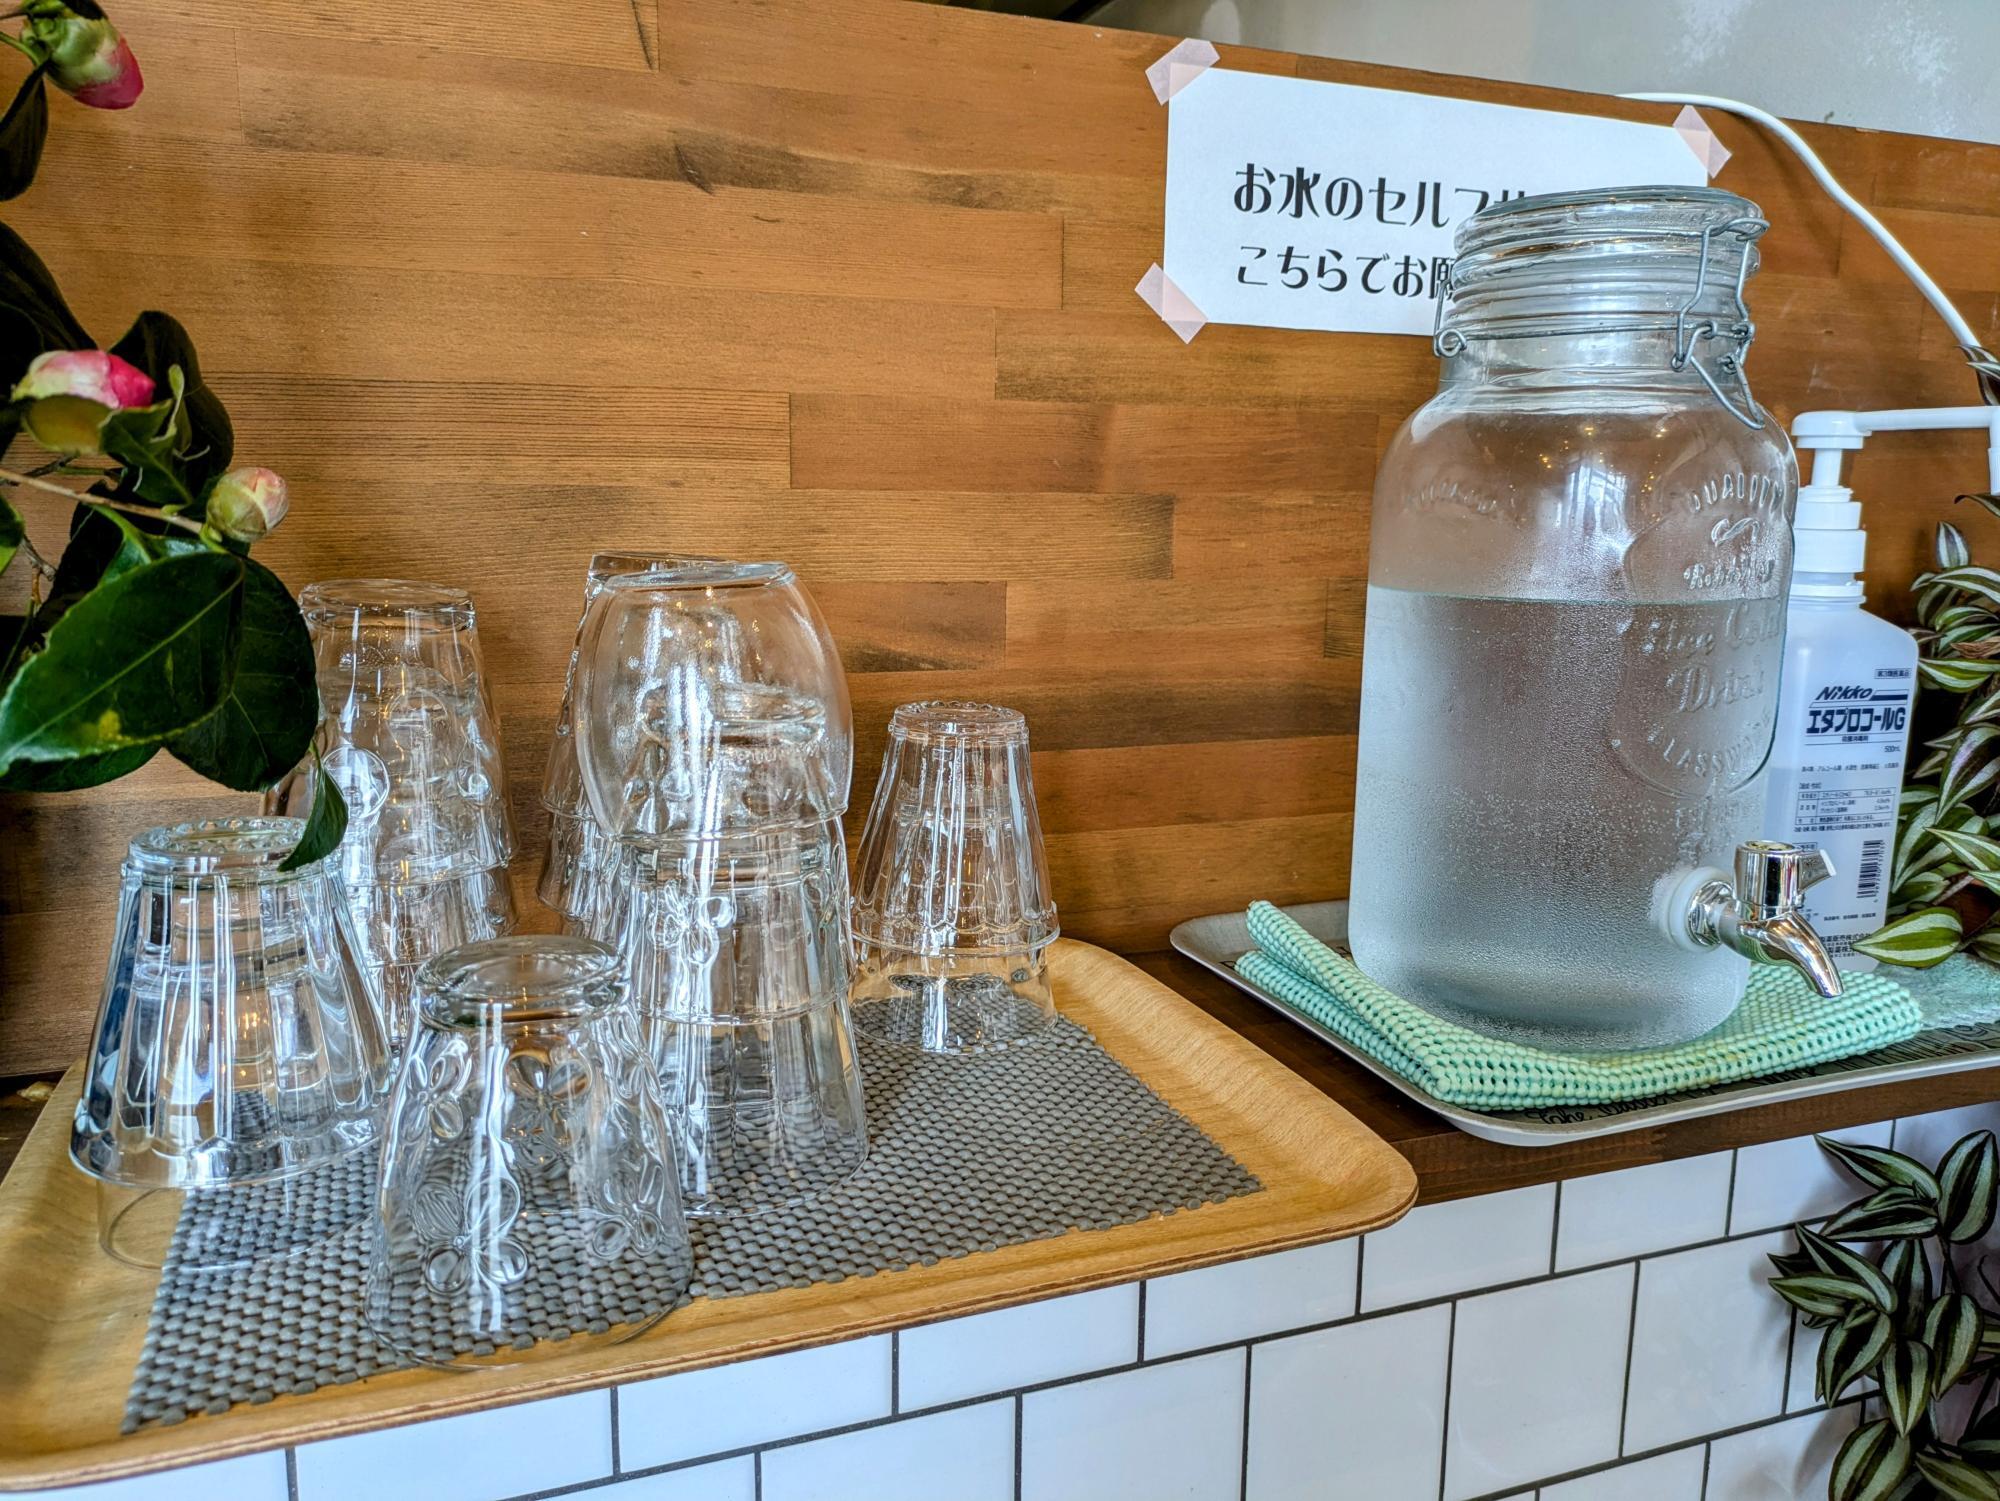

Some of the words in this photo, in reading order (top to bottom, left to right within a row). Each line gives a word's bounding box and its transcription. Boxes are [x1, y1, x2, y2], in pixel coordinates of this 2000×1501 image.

[1234, 163, 1525, 228] お水のセルフ
[1815, 685, 1873, 700] Nikko
[1806, 707, 1906, 734] エタプロコールG
